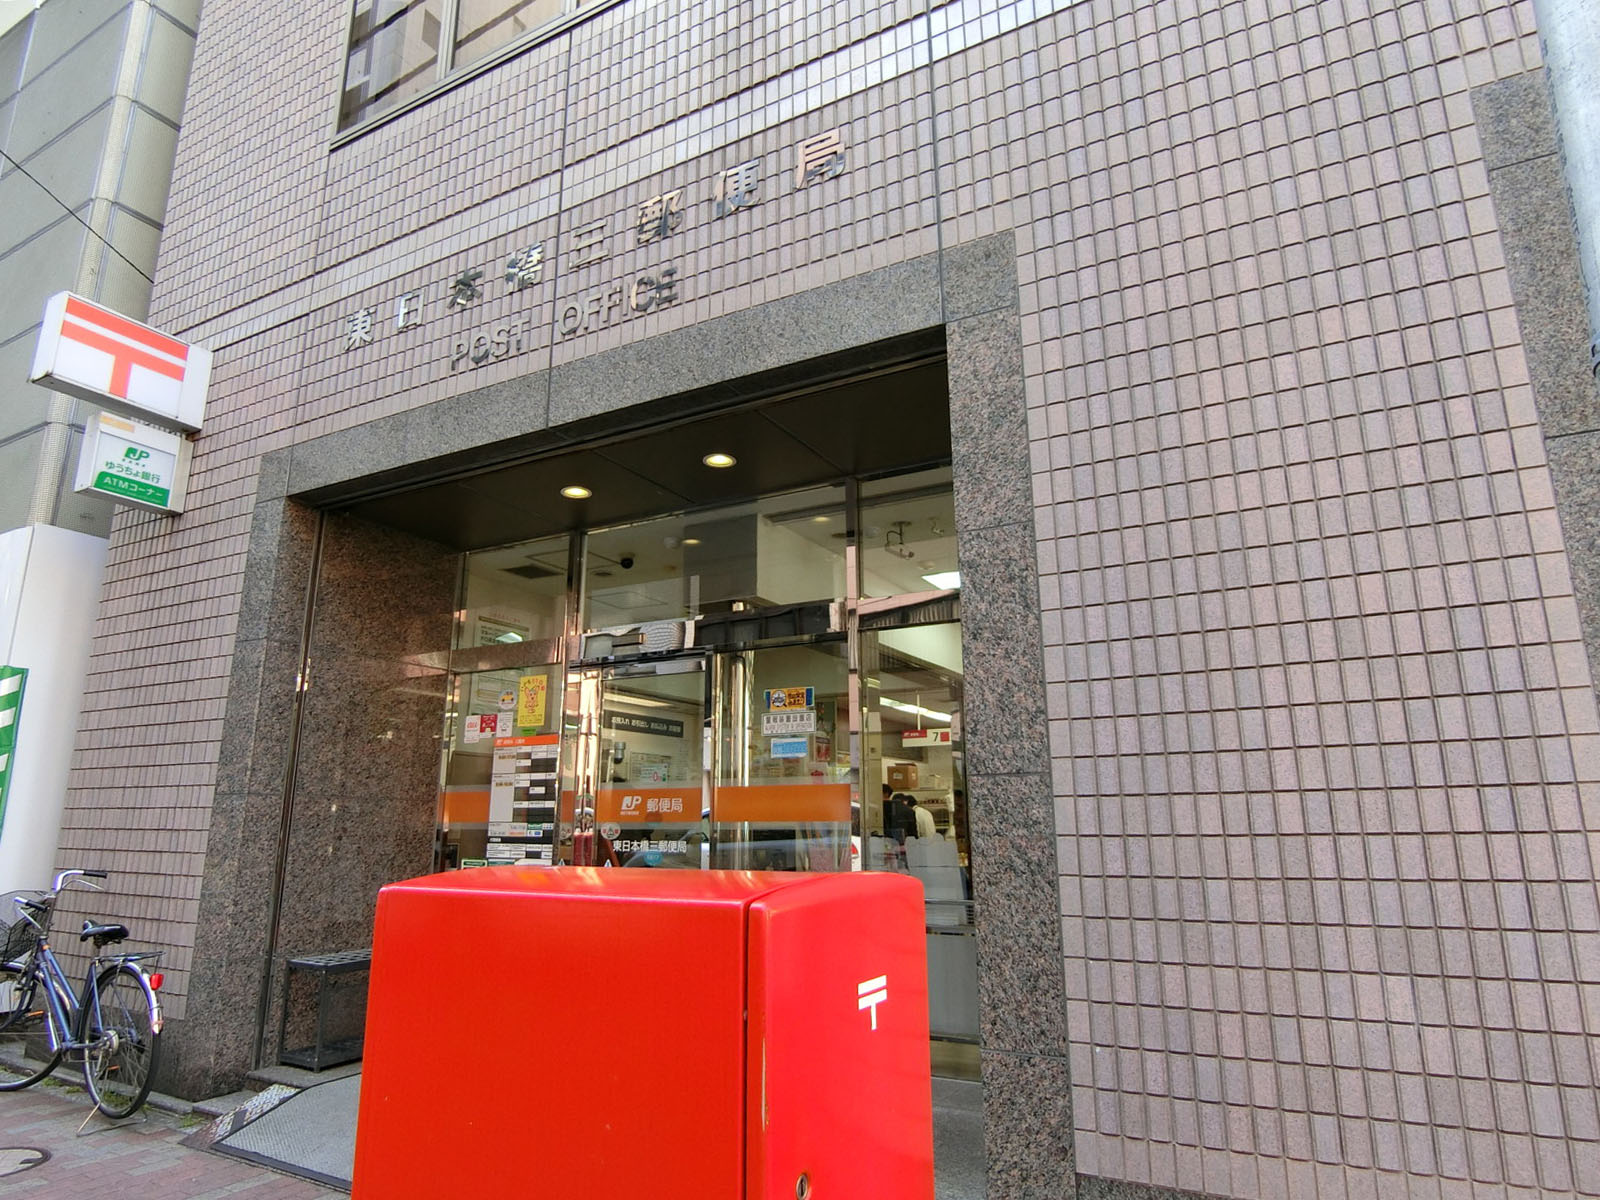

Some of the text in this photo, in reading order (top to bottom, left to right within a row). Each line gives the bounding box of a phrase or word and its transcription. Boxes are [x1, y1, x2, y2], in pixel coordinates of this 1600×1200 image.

[343, 129, 846, 352] 東日本橋三郵便局
[450, 267, 679, 371] POST OFFICE
[124, 447, 150, 461] JP
[105, 461, 161, 484] ゆうちょ銀行
[103, 476, 164, 498] ATMコーナー
[932, 731, 939, 742] 7
[621, 795, 643, 811] JP
[646, 797, 684, 813] 郵便局
[613, 839, 688, 853] 東日本橋三郵便局
